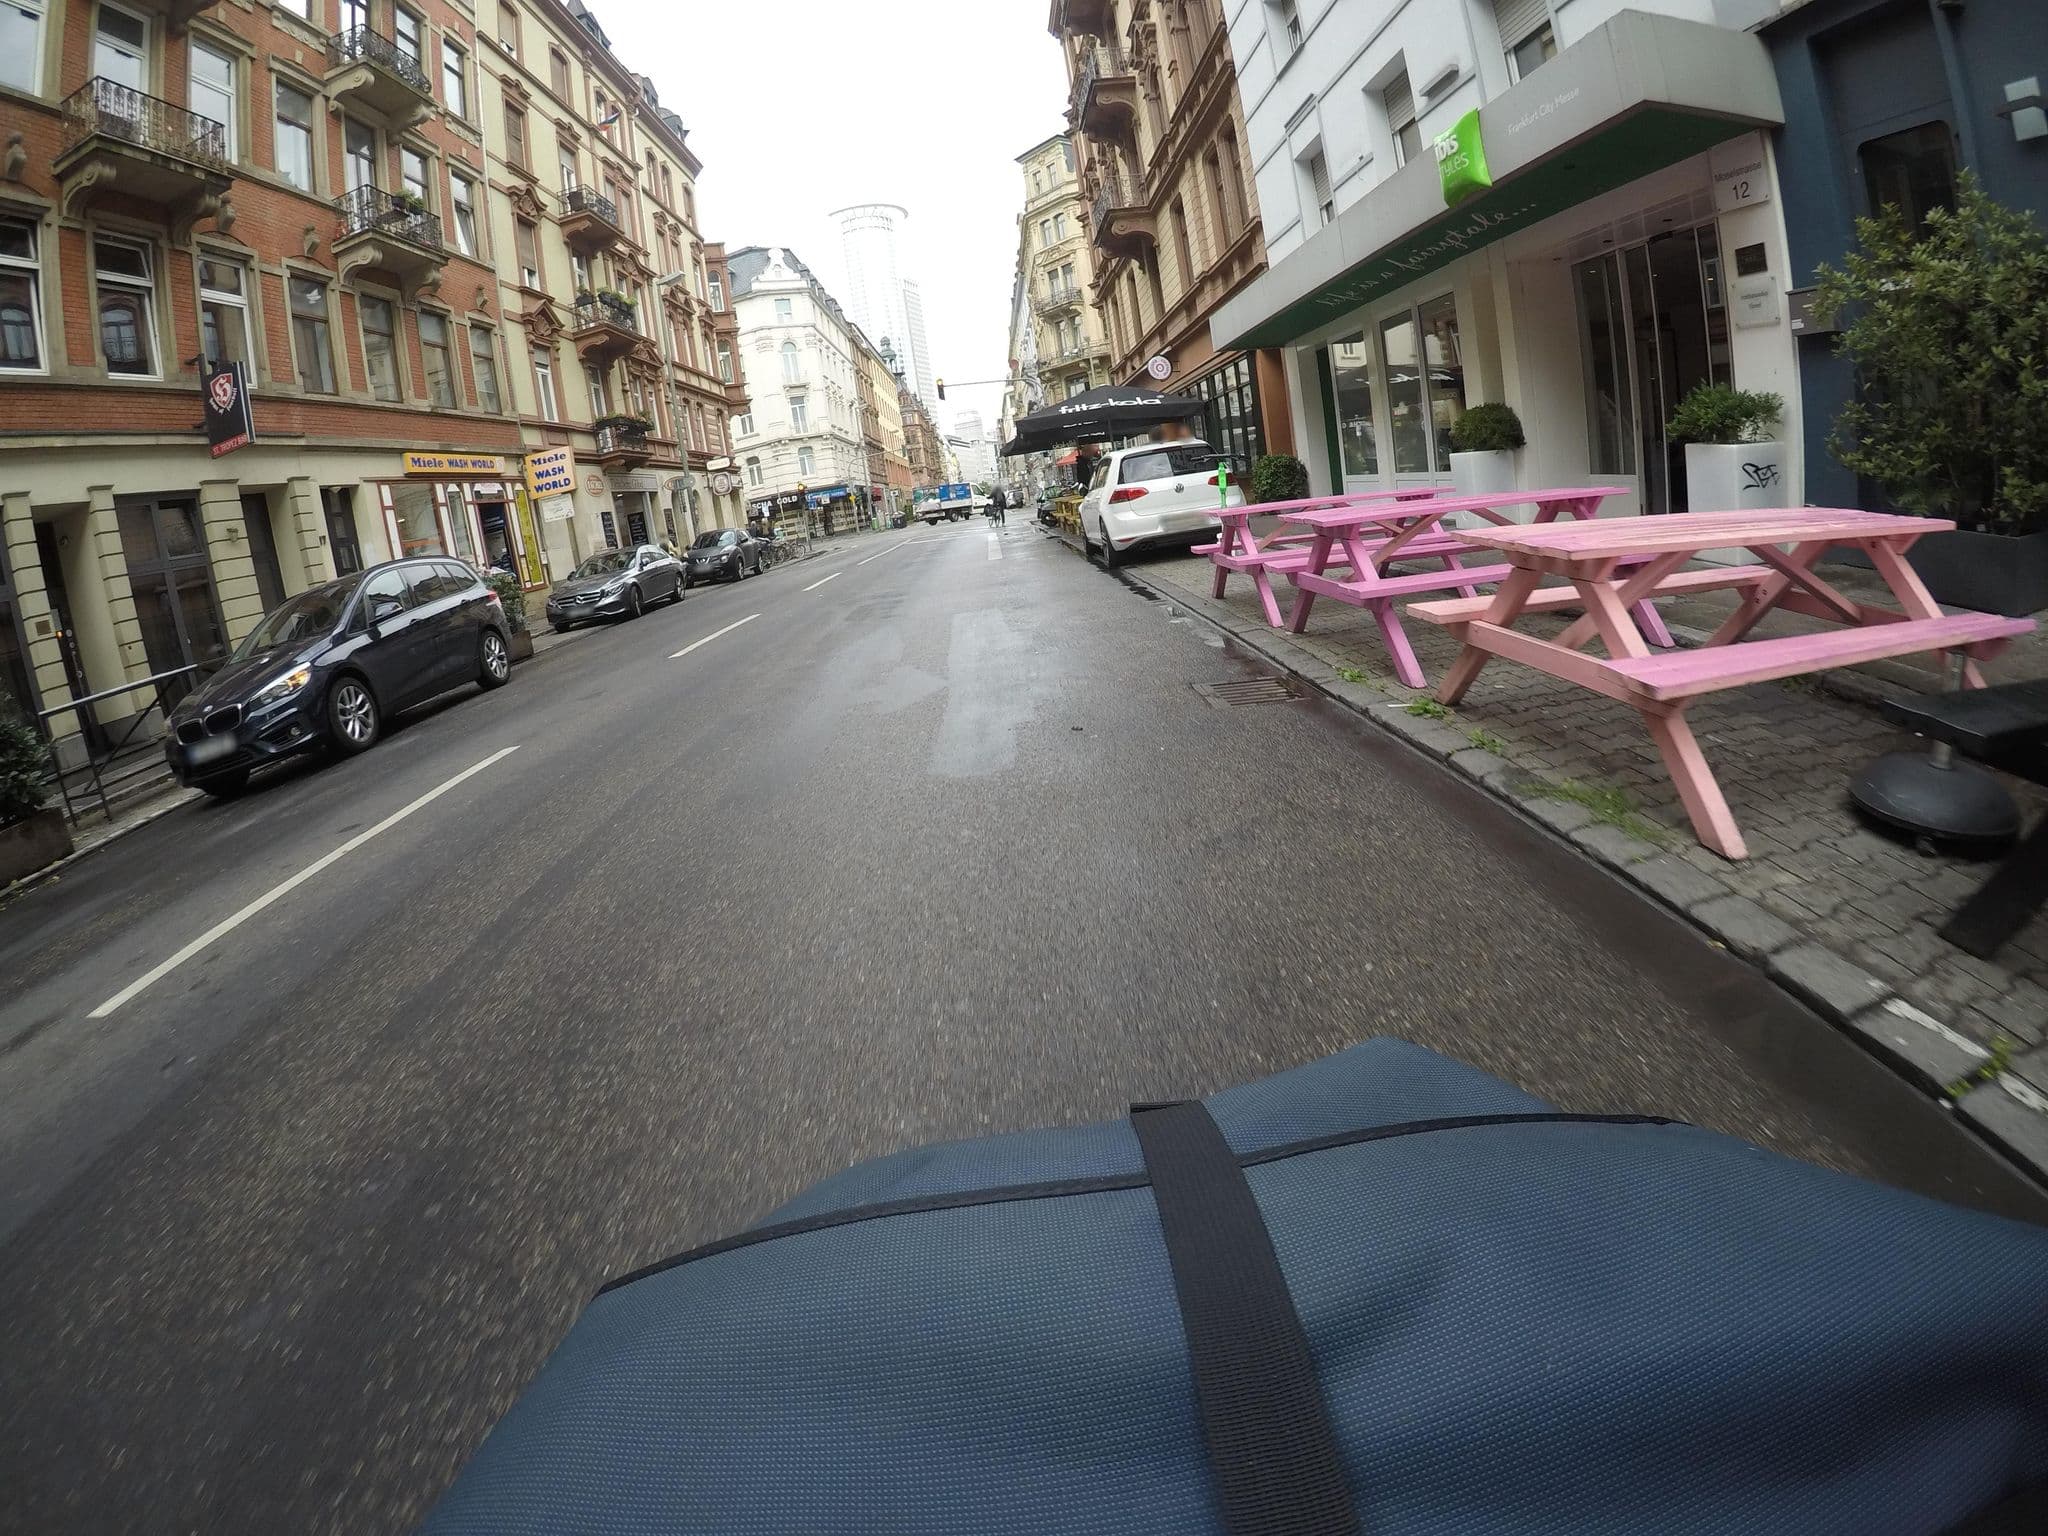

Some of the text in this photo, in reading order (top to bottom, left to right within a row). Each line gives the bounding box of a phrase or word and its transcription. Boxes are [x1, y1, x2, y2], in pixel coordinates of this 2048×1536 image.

[1732, 181, 1750, 200] 12
[410, 457, 495, 469] Miele WASH WORLD
[531, 452, 567, 466] Miele
[535, 465, 565, 480] WASH
[534, 477, 571, 493] WORLD
[776, 495, 798, 505] GOLD
